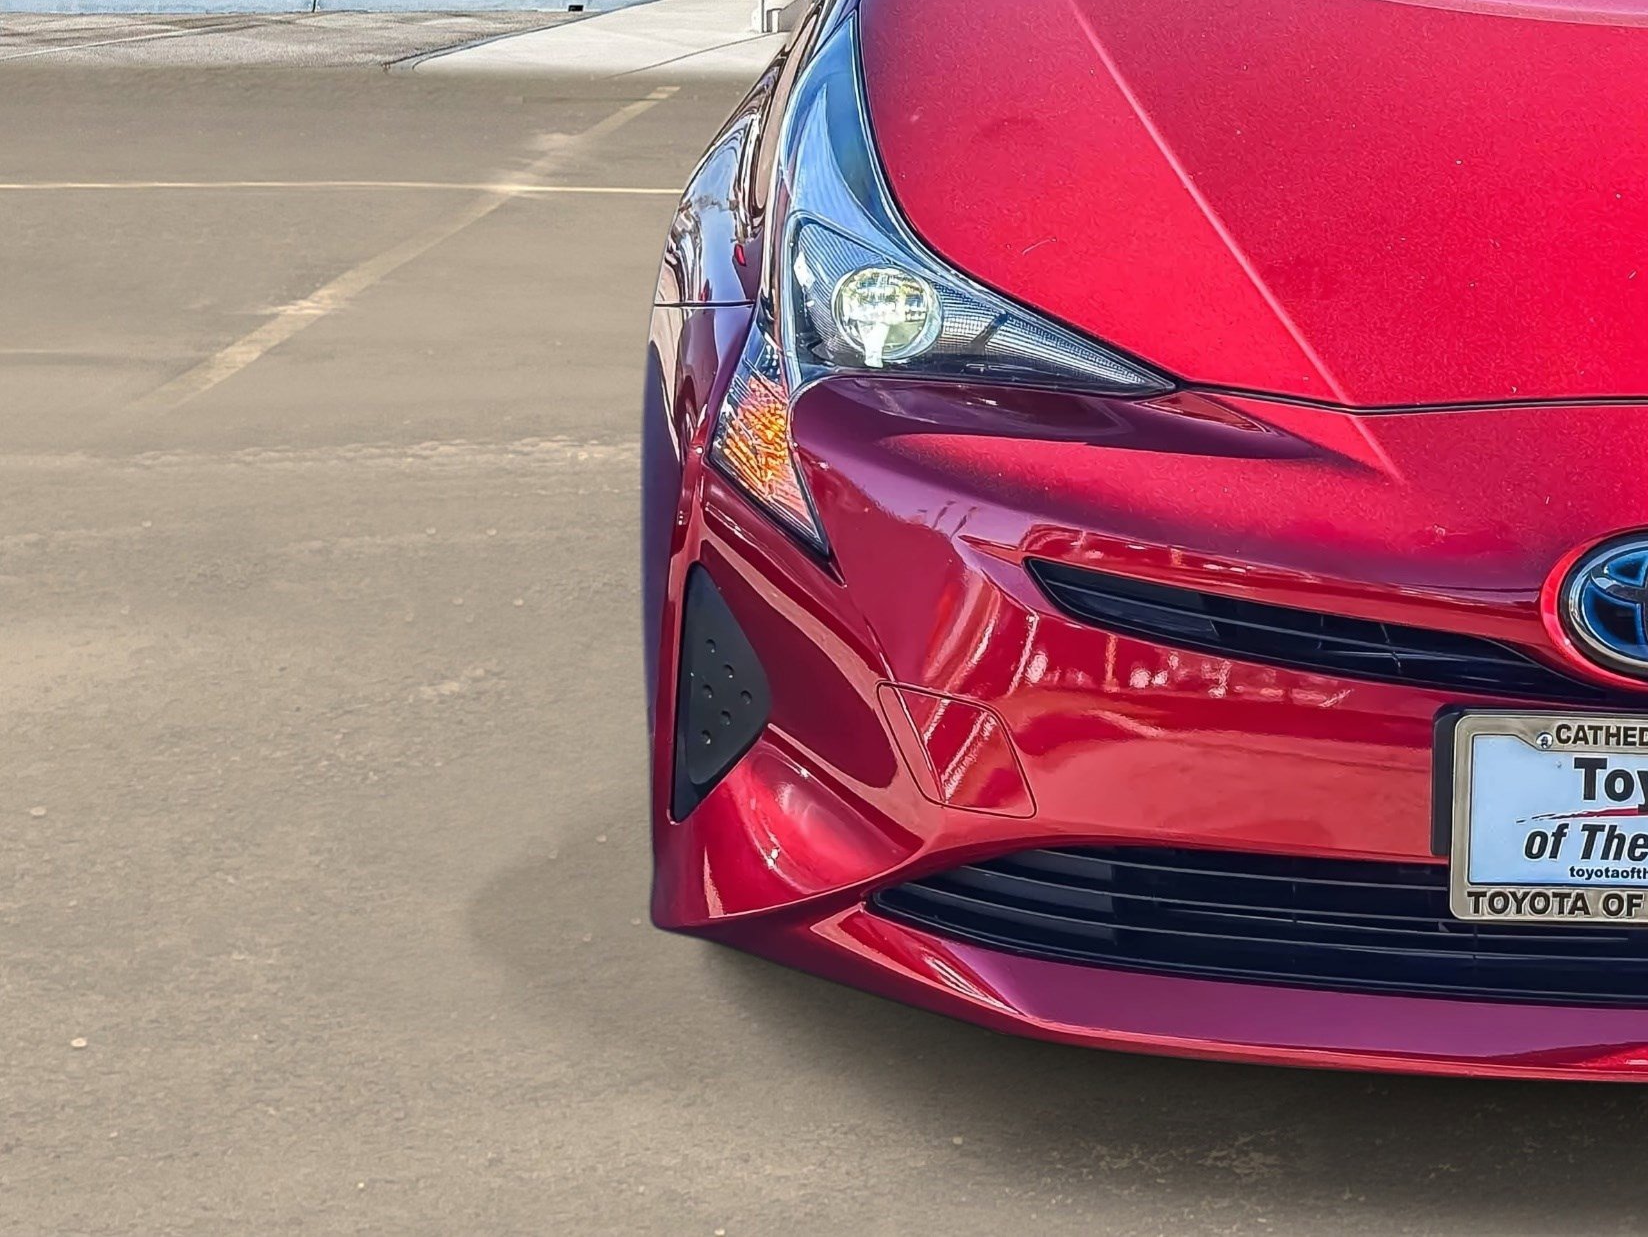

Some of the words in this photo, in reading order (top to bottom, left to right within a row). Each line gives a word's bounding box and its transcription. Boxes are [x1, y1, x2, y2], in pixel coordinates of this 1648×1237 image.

[1524, 823, 1570, 861] of
[1467, 890, 1590, 917] TOYOTA
[1601, 891, 1644, 919] OF
